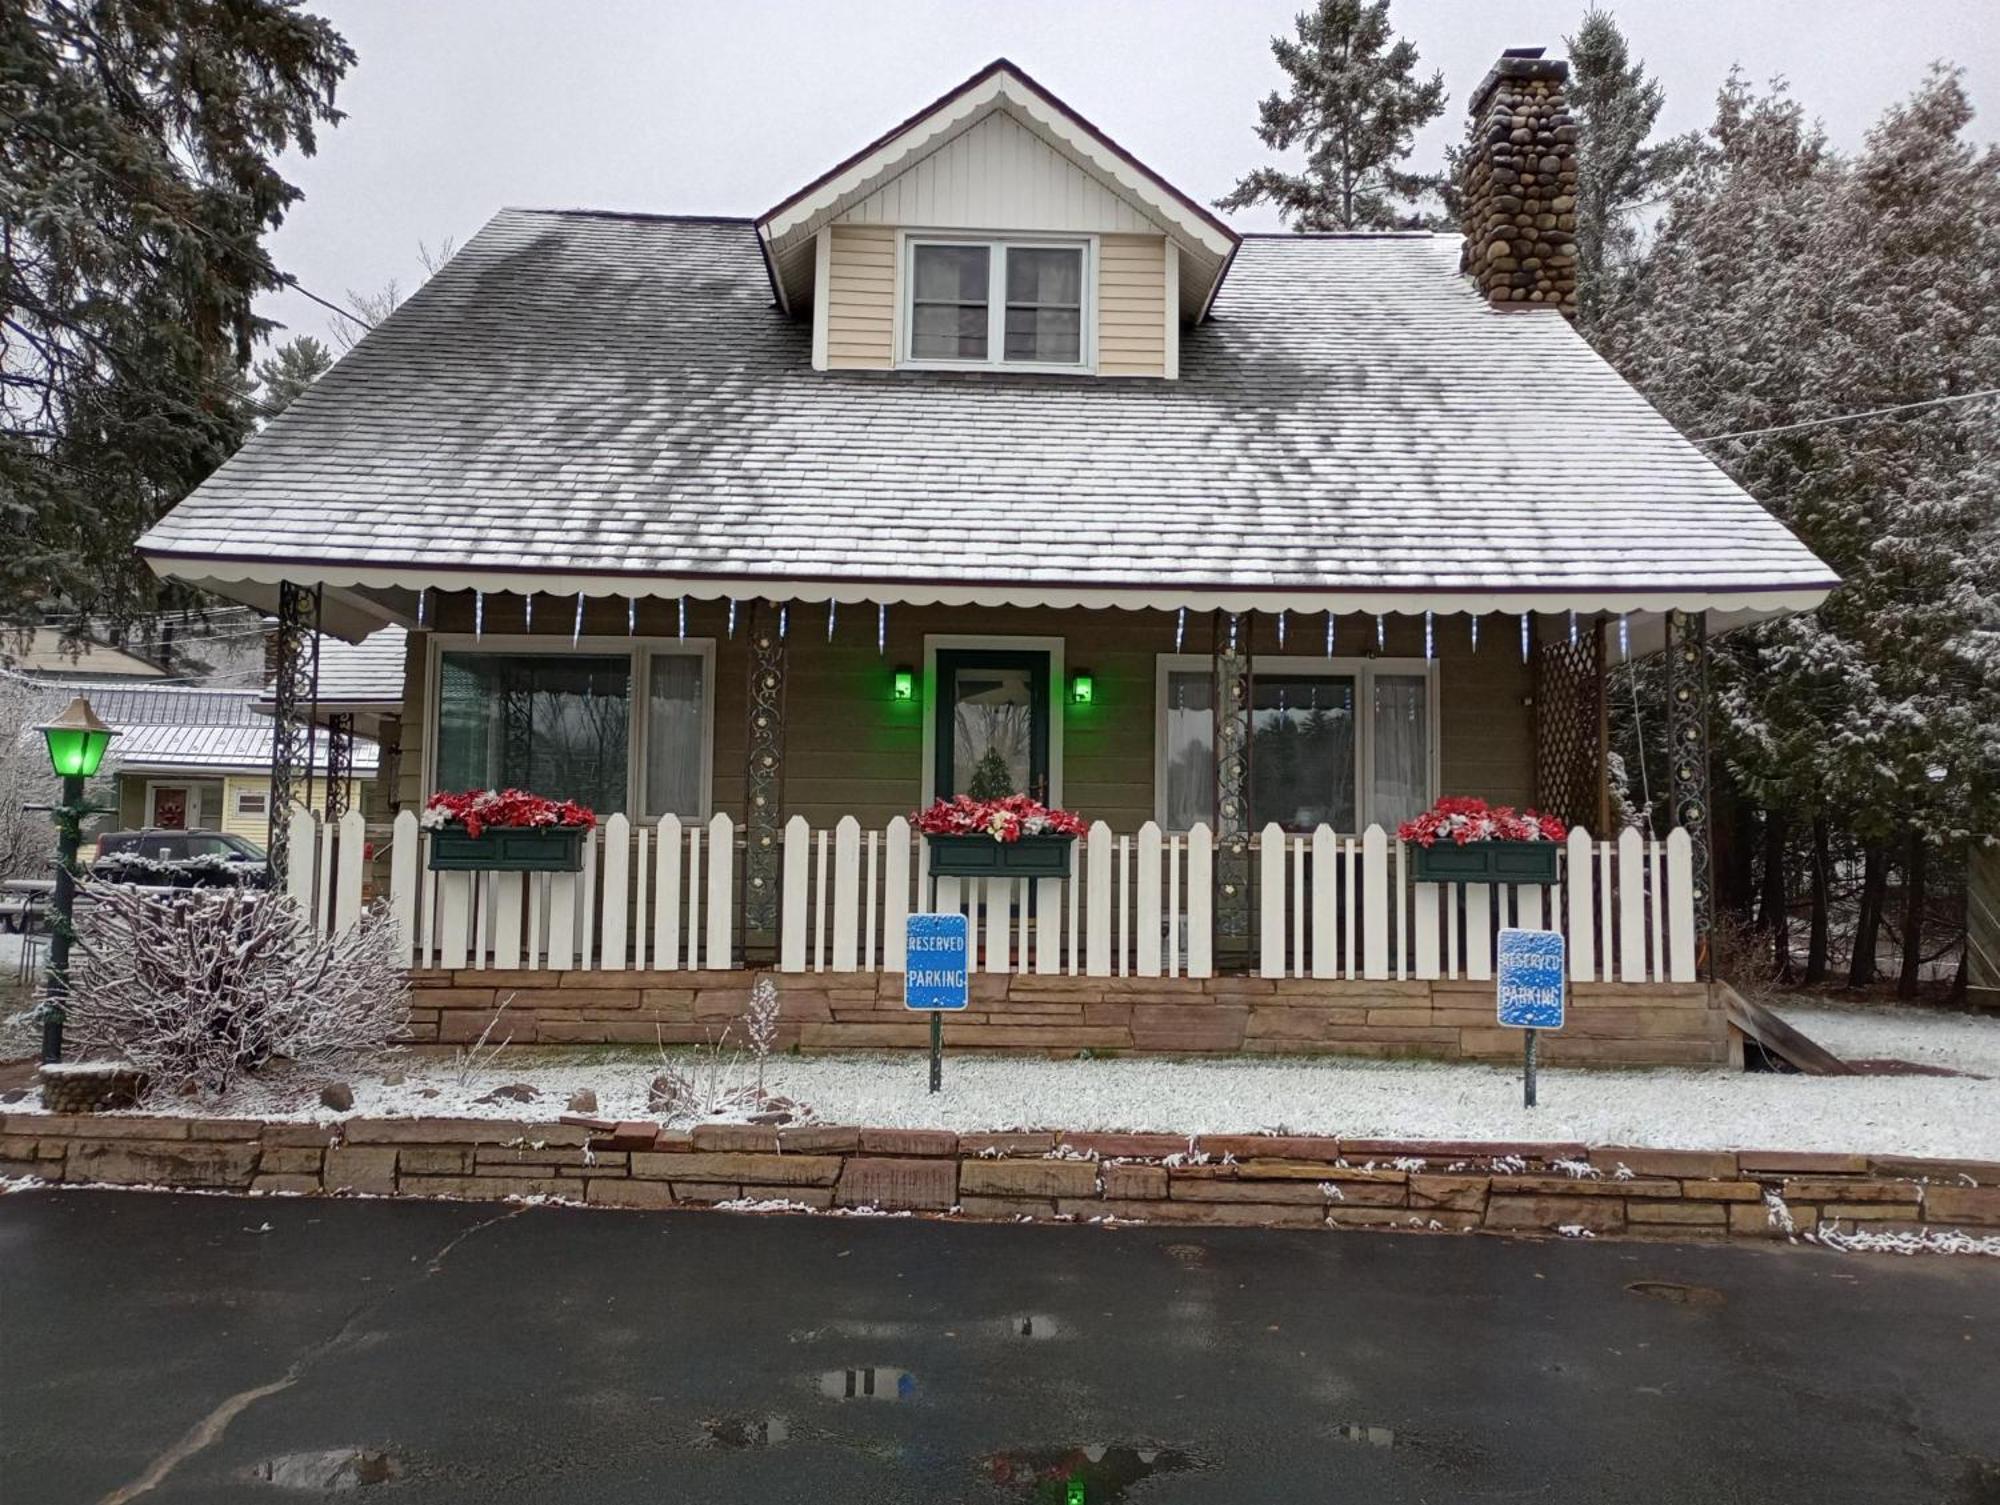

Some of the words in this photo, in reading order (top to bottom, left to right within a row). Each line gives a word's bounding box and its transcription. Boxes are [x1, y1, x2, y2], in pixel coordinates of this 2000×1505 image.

[908, 936, 964, 951] RESERVED
[1501, 953, 1560, 970] RESERVED
[909, 970, 963, 988] PARKING
[1502, 986, 1559, 1008] PARKING
